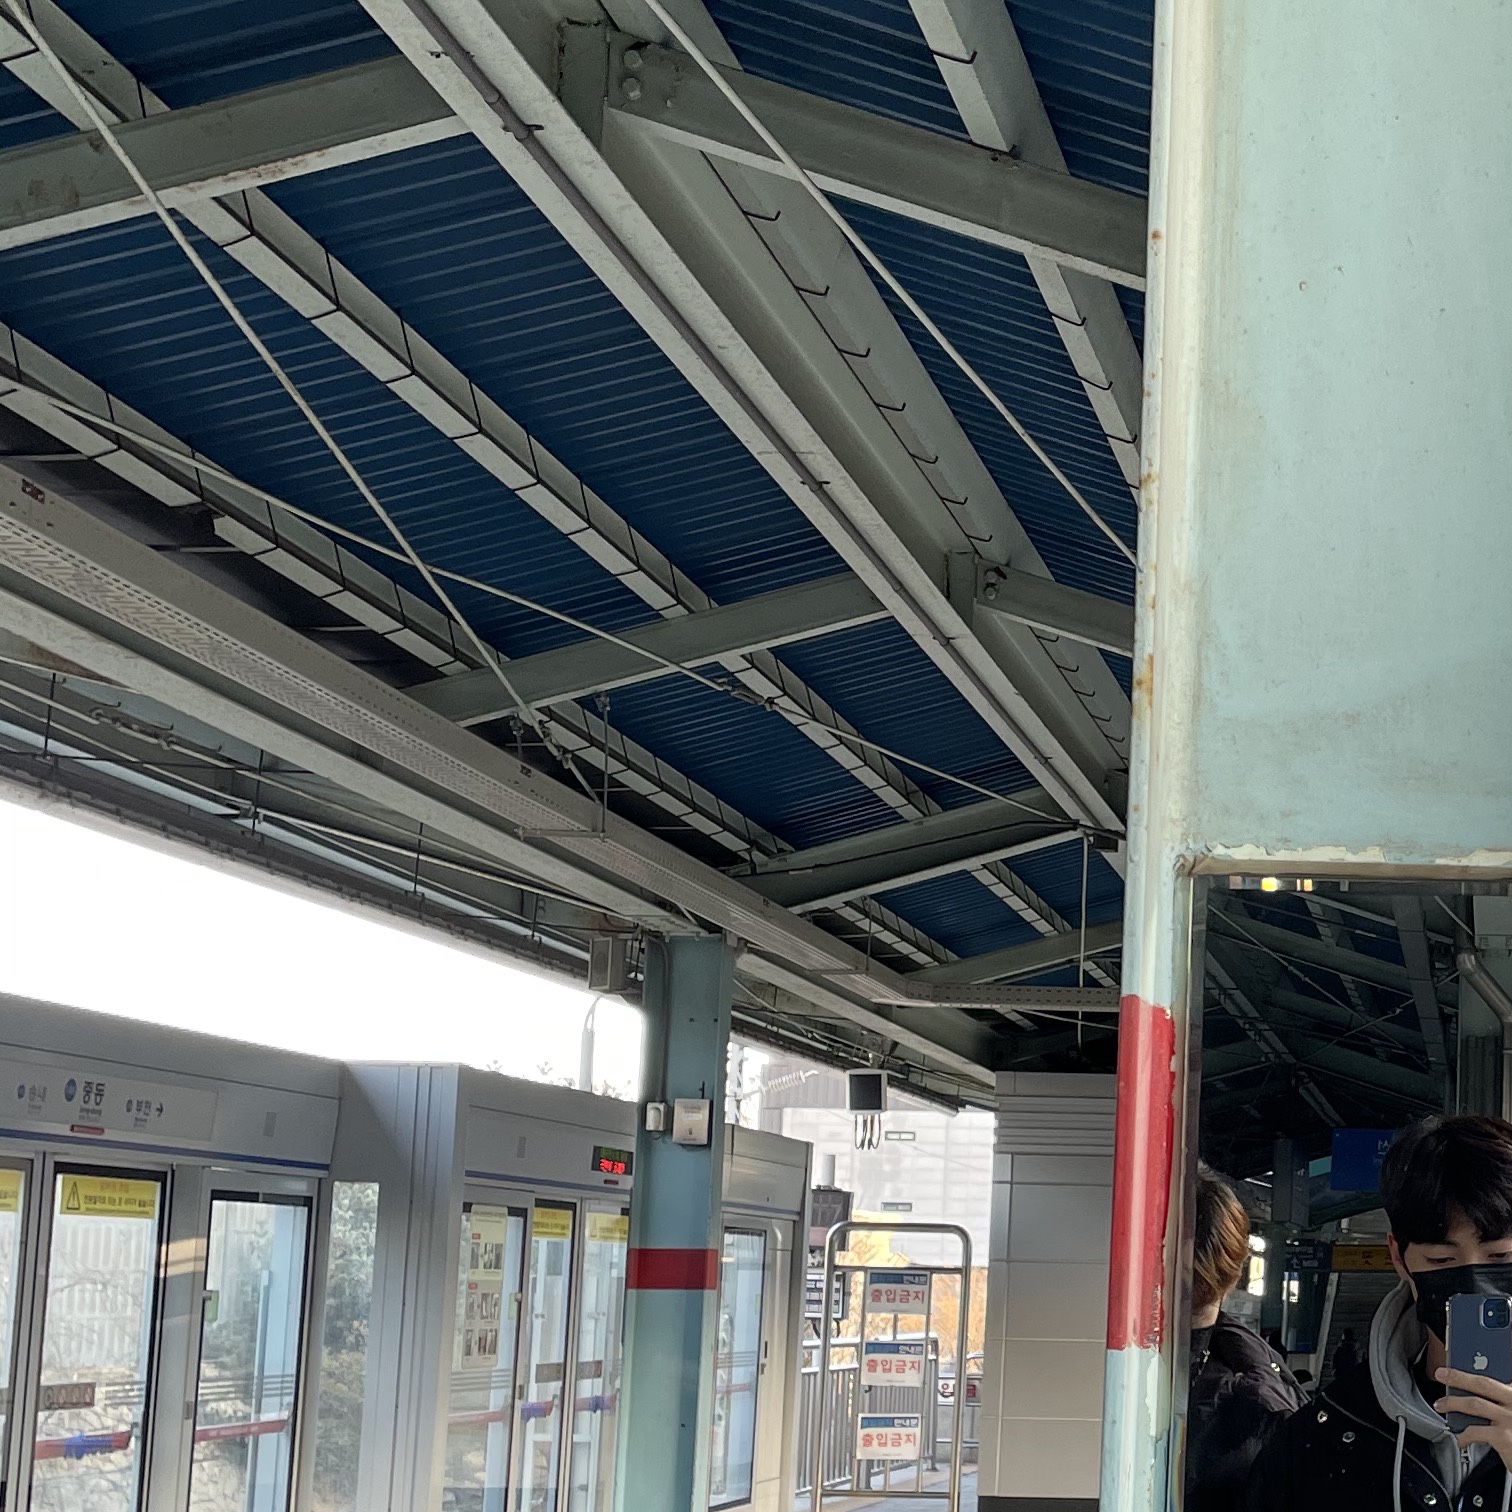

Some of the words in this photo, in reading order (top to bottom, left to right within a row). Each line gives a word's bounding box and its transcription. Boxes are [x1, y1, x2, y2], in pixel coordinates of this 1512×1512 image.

[83, 1080, 106, 1106] 중동
[871, 1288, 925, 1304] 출입금지
[867, 1359, 920, 1374] 출입금지
[862, 1432, 916, 1447] 출입금지
